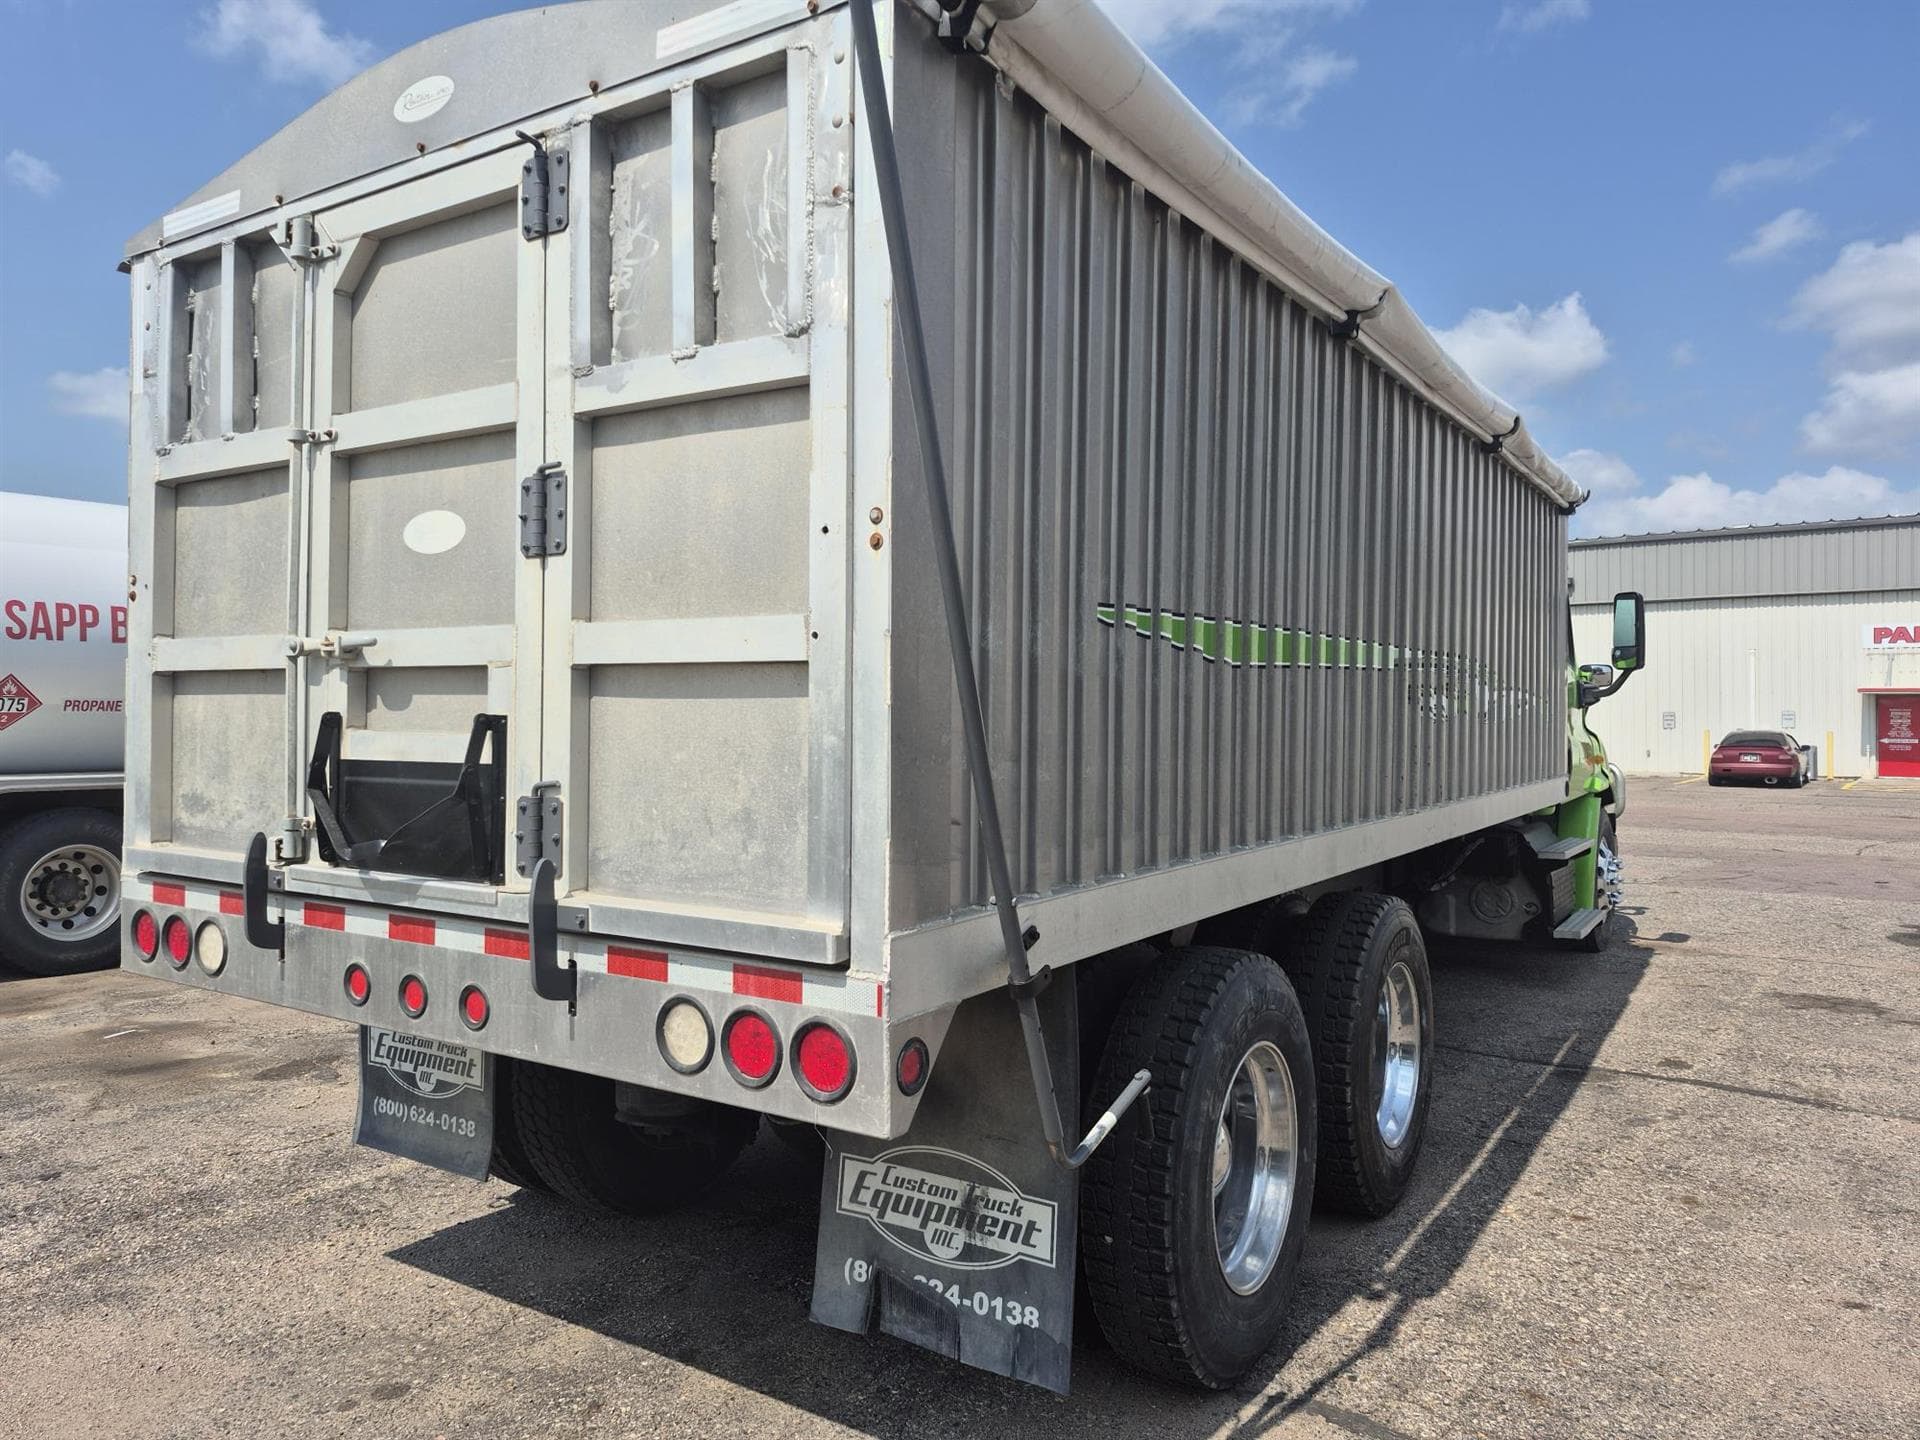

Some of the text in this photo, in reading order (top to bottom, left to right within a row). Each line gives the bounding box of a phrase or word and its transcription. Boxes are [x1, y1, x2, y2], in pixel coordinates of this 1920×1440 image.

[5, 599, 100, 642] SAPP
[63, 699, 123, 712] PROPANE
[374, 1032, 477, 1079] Equipment
[849, 1170, 1043, 1249] Equipment
[880, 1164, 1024, 1218] Custom Truck
